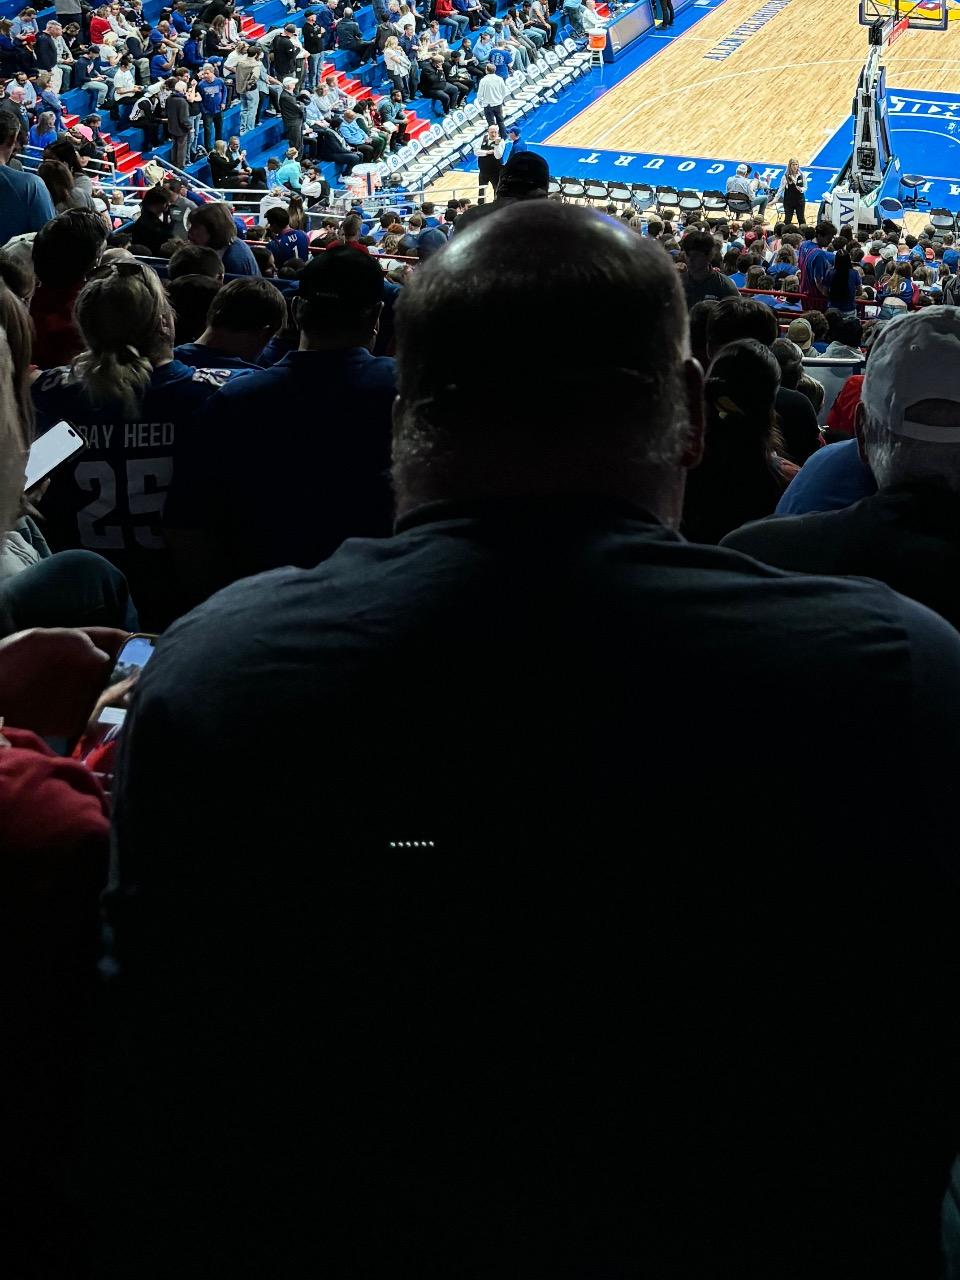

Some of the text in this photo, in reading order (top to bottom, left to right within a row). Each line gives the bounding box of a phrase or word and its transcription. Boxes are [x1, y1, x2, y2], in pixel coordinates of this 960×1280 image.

[702, 37, 747, 62] ALLEN
[578, 152, 725, 175] COURT
[124, 422, 175, 448] HEED
[74, 456, 174, 550] 25
